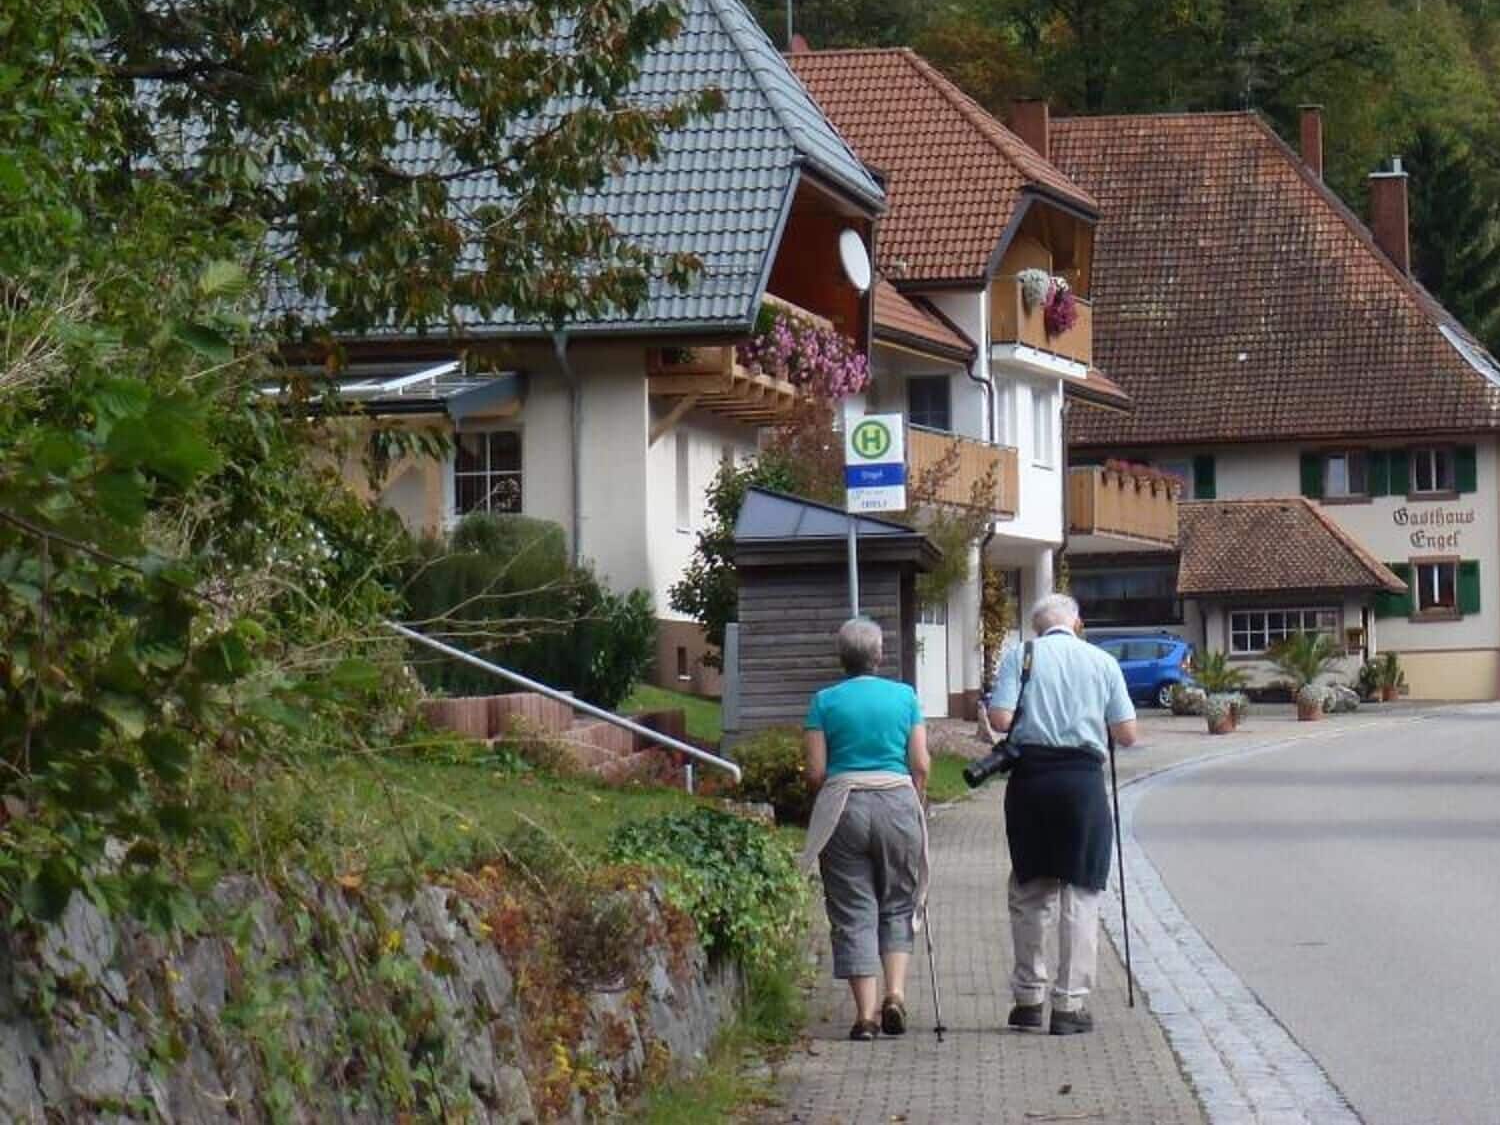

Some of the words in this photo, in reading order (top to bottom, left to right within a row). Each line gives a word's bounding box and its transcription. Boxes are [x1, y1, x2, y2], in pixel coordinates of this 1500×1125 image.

[862, 429, 881, 450] H
[1393, 507, 1474, 526] Gasthaus
[1410, 530, 1459, 551] Engel
